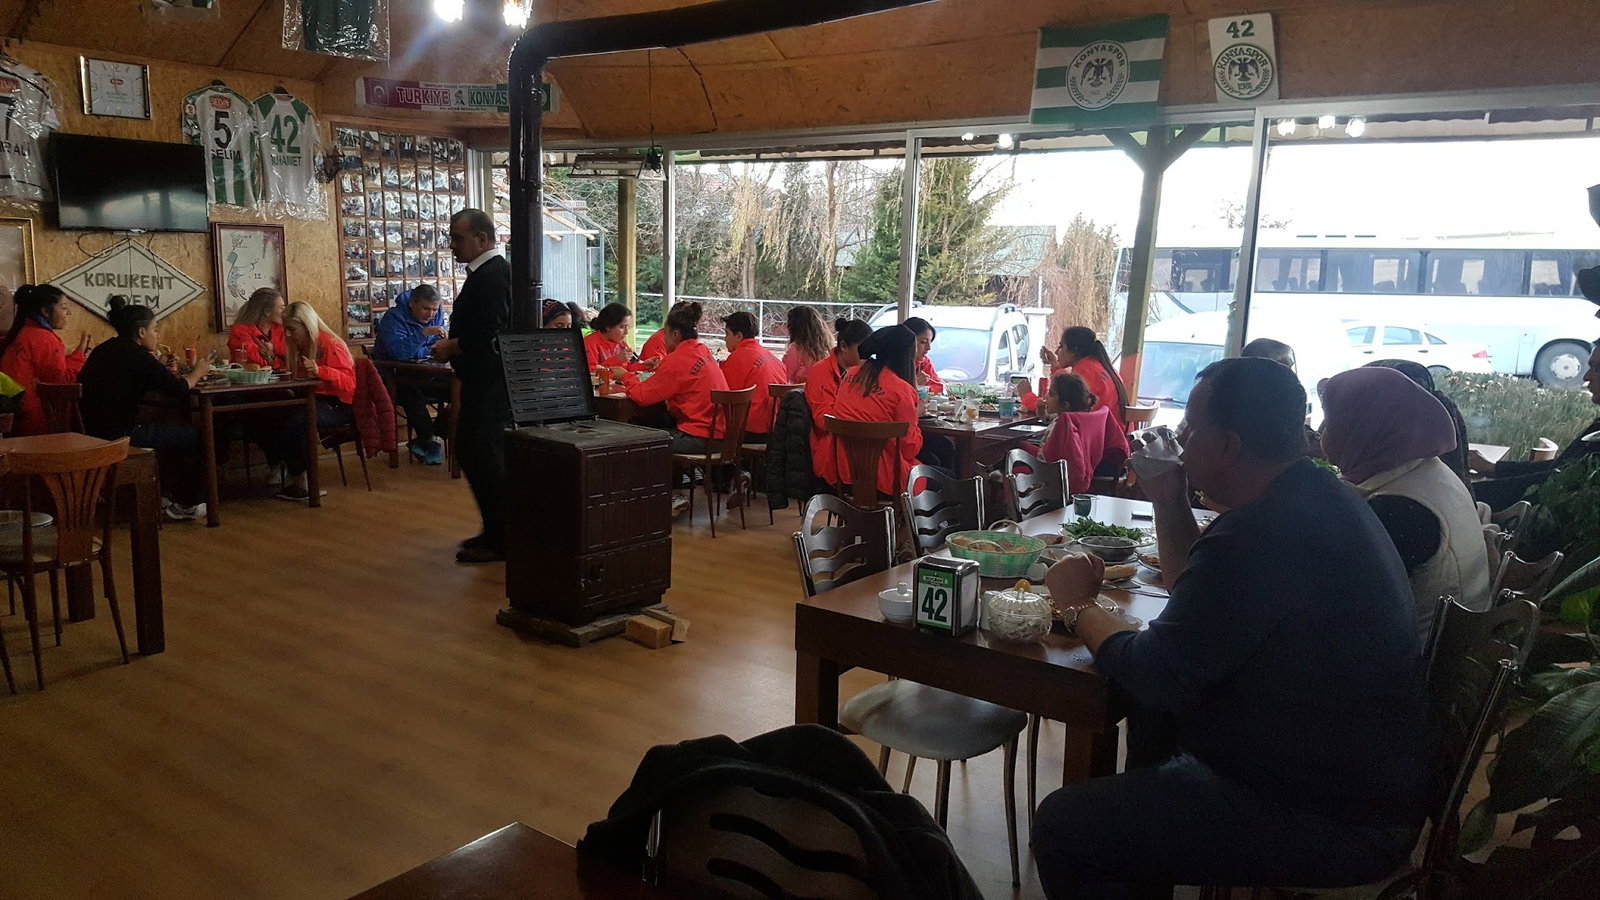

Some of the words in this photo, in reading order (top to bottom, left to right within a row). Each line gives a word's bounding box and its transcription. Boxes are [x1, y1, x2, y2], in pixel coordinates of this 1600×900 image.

[1226, 19, 1255, 38] 42
[1073, 44, 1126, 68] KONYASPOR
[1217, 47, 1269, 70] KONYASPOR
[214, 110, 232, 149] 5
[271, 114, 301, 154] 42
[84, 272, 176, 290] KORUKENT
[921, 587, 948, 623] 42
